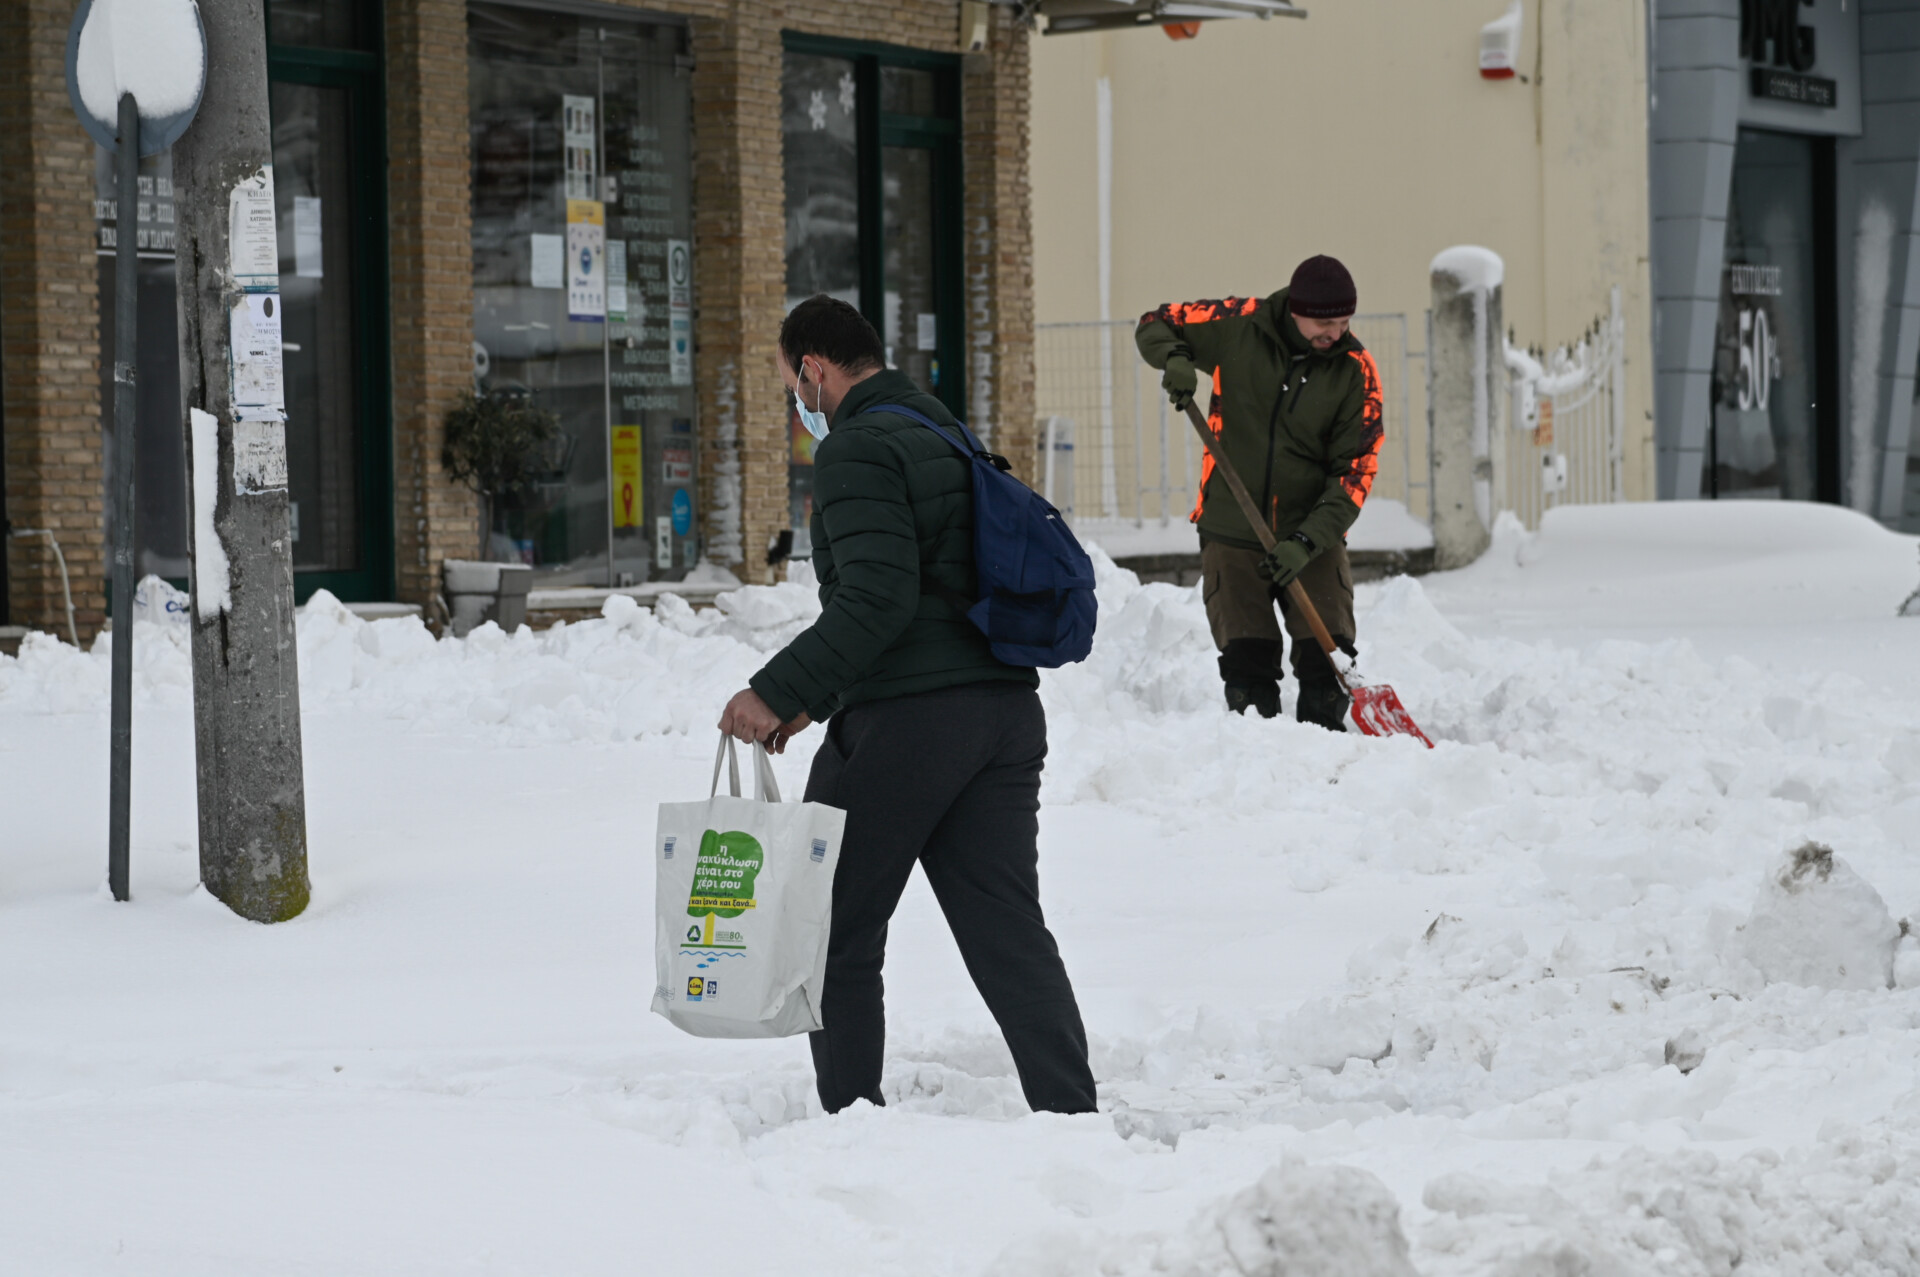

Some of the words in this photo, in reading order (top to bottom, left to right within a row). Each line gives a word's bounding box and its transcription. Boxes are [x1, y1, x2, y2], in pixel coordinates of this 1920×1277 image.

[719, 845, 728, 856] η
[696, 865, 722, 877] είναι
[724, 869, 744, 878] στο
[696, 876, 718, 890] χέρι
[720, 880, 742, 889] σου
